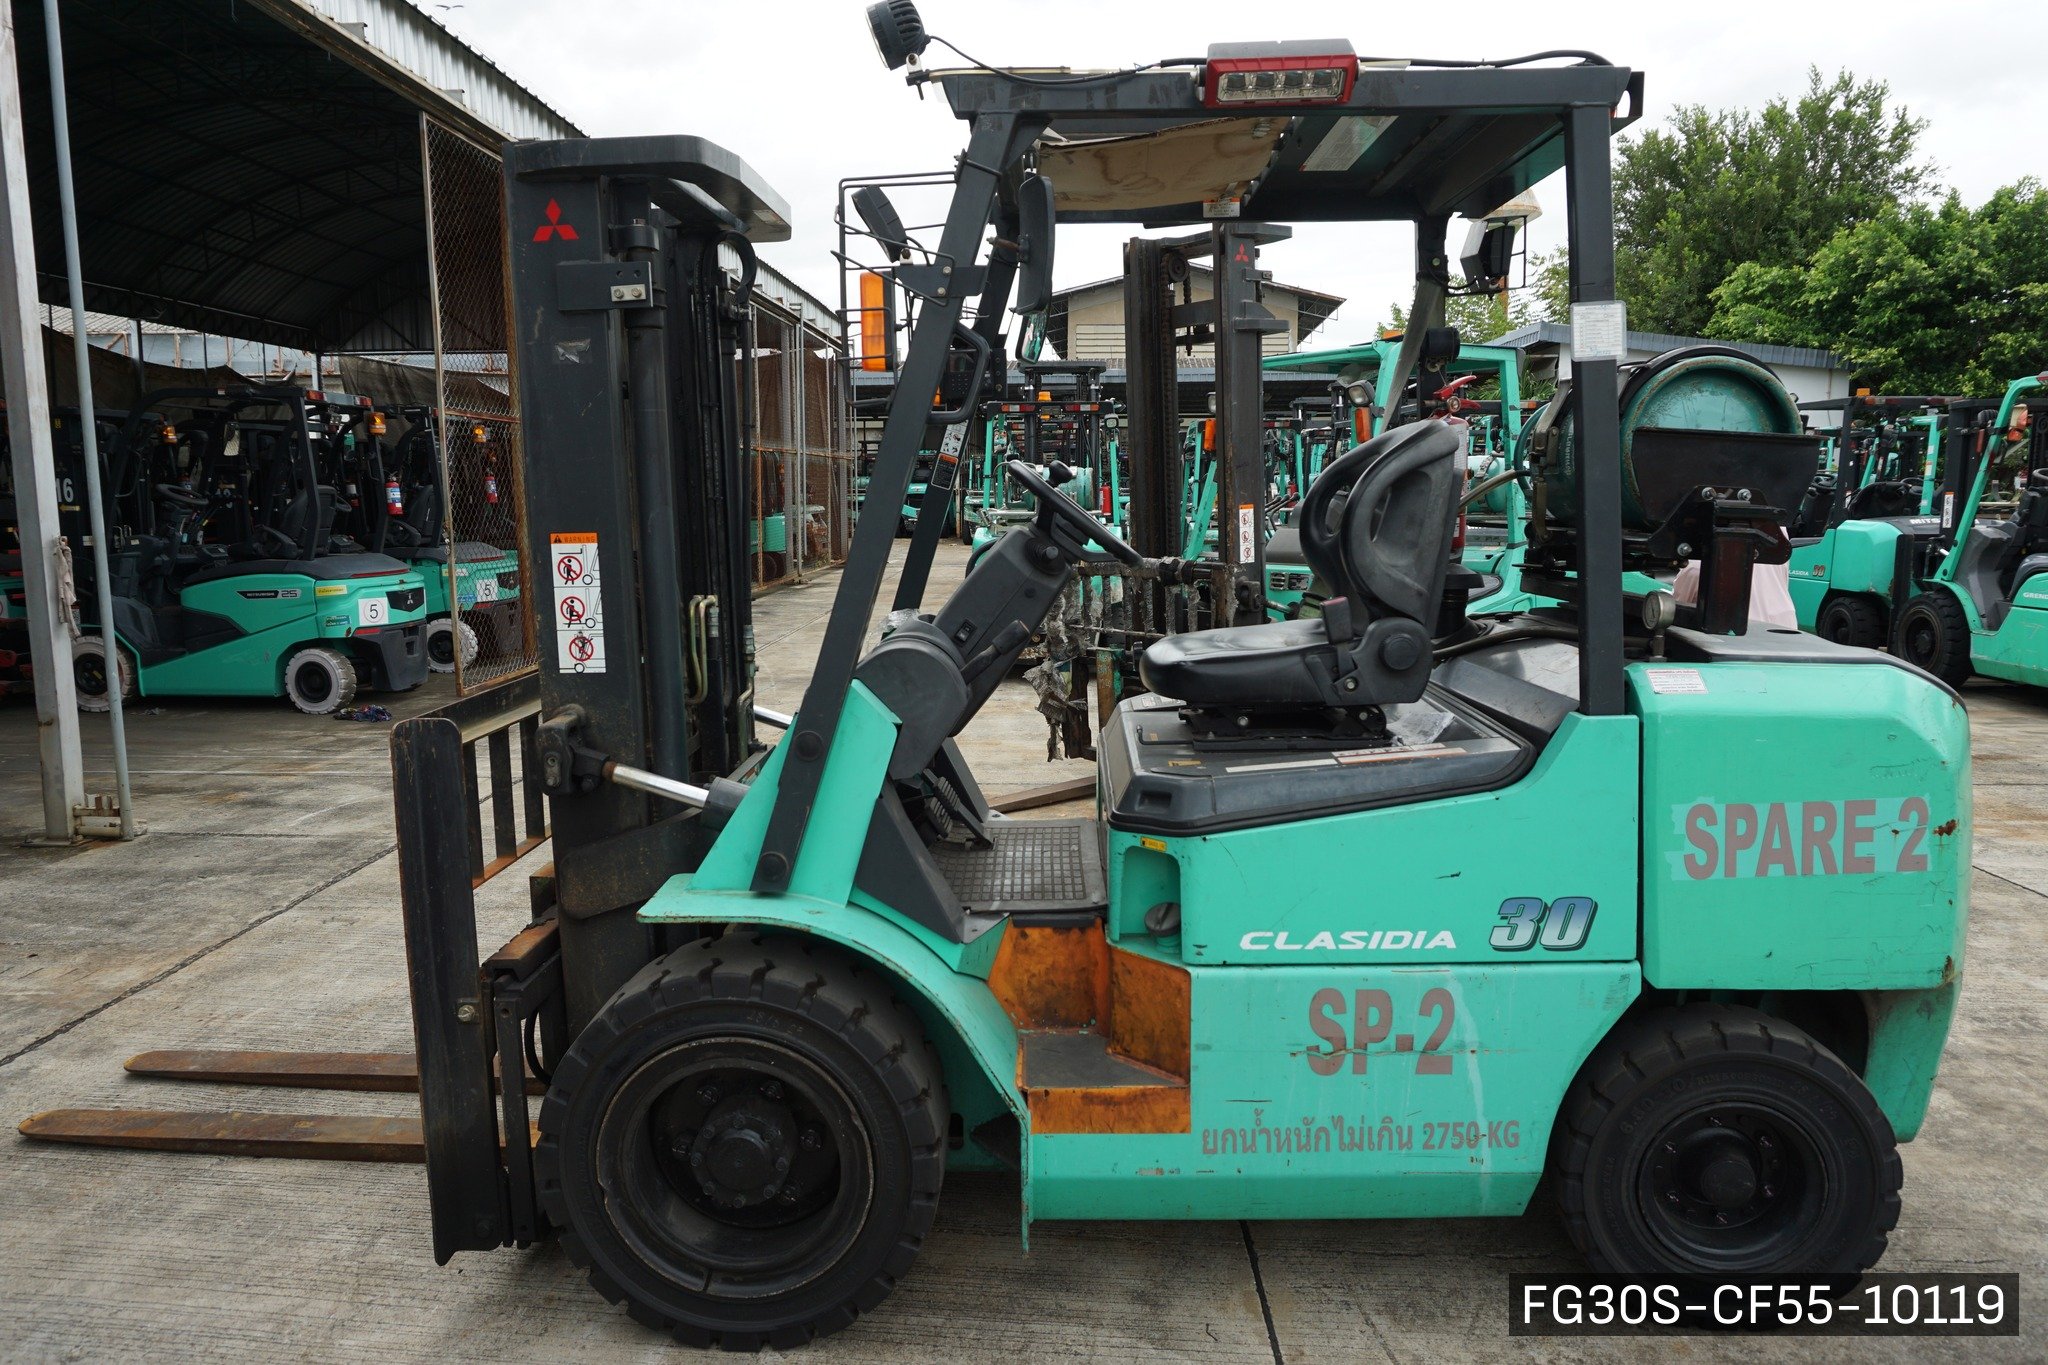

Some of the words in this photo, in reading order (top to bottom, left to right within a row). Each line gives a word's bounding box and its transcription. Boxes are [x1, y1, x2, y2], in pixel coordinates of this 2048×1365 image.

[369, 603, 379, 619] 5
[1683, 800, 1877, 880] SPARE
[1896, 797, 1929, 872] 2
[1239, 930, 1457, 950] CLASIDIA
[1489, 896, 1599, 952] 30
[1201, 1108, 1413, 1155] ยกน้ำหนักไม่เกิน
[1422, 1121, 1480, 1150] 2750
[1487, 1120, 1521, 1148] KG
